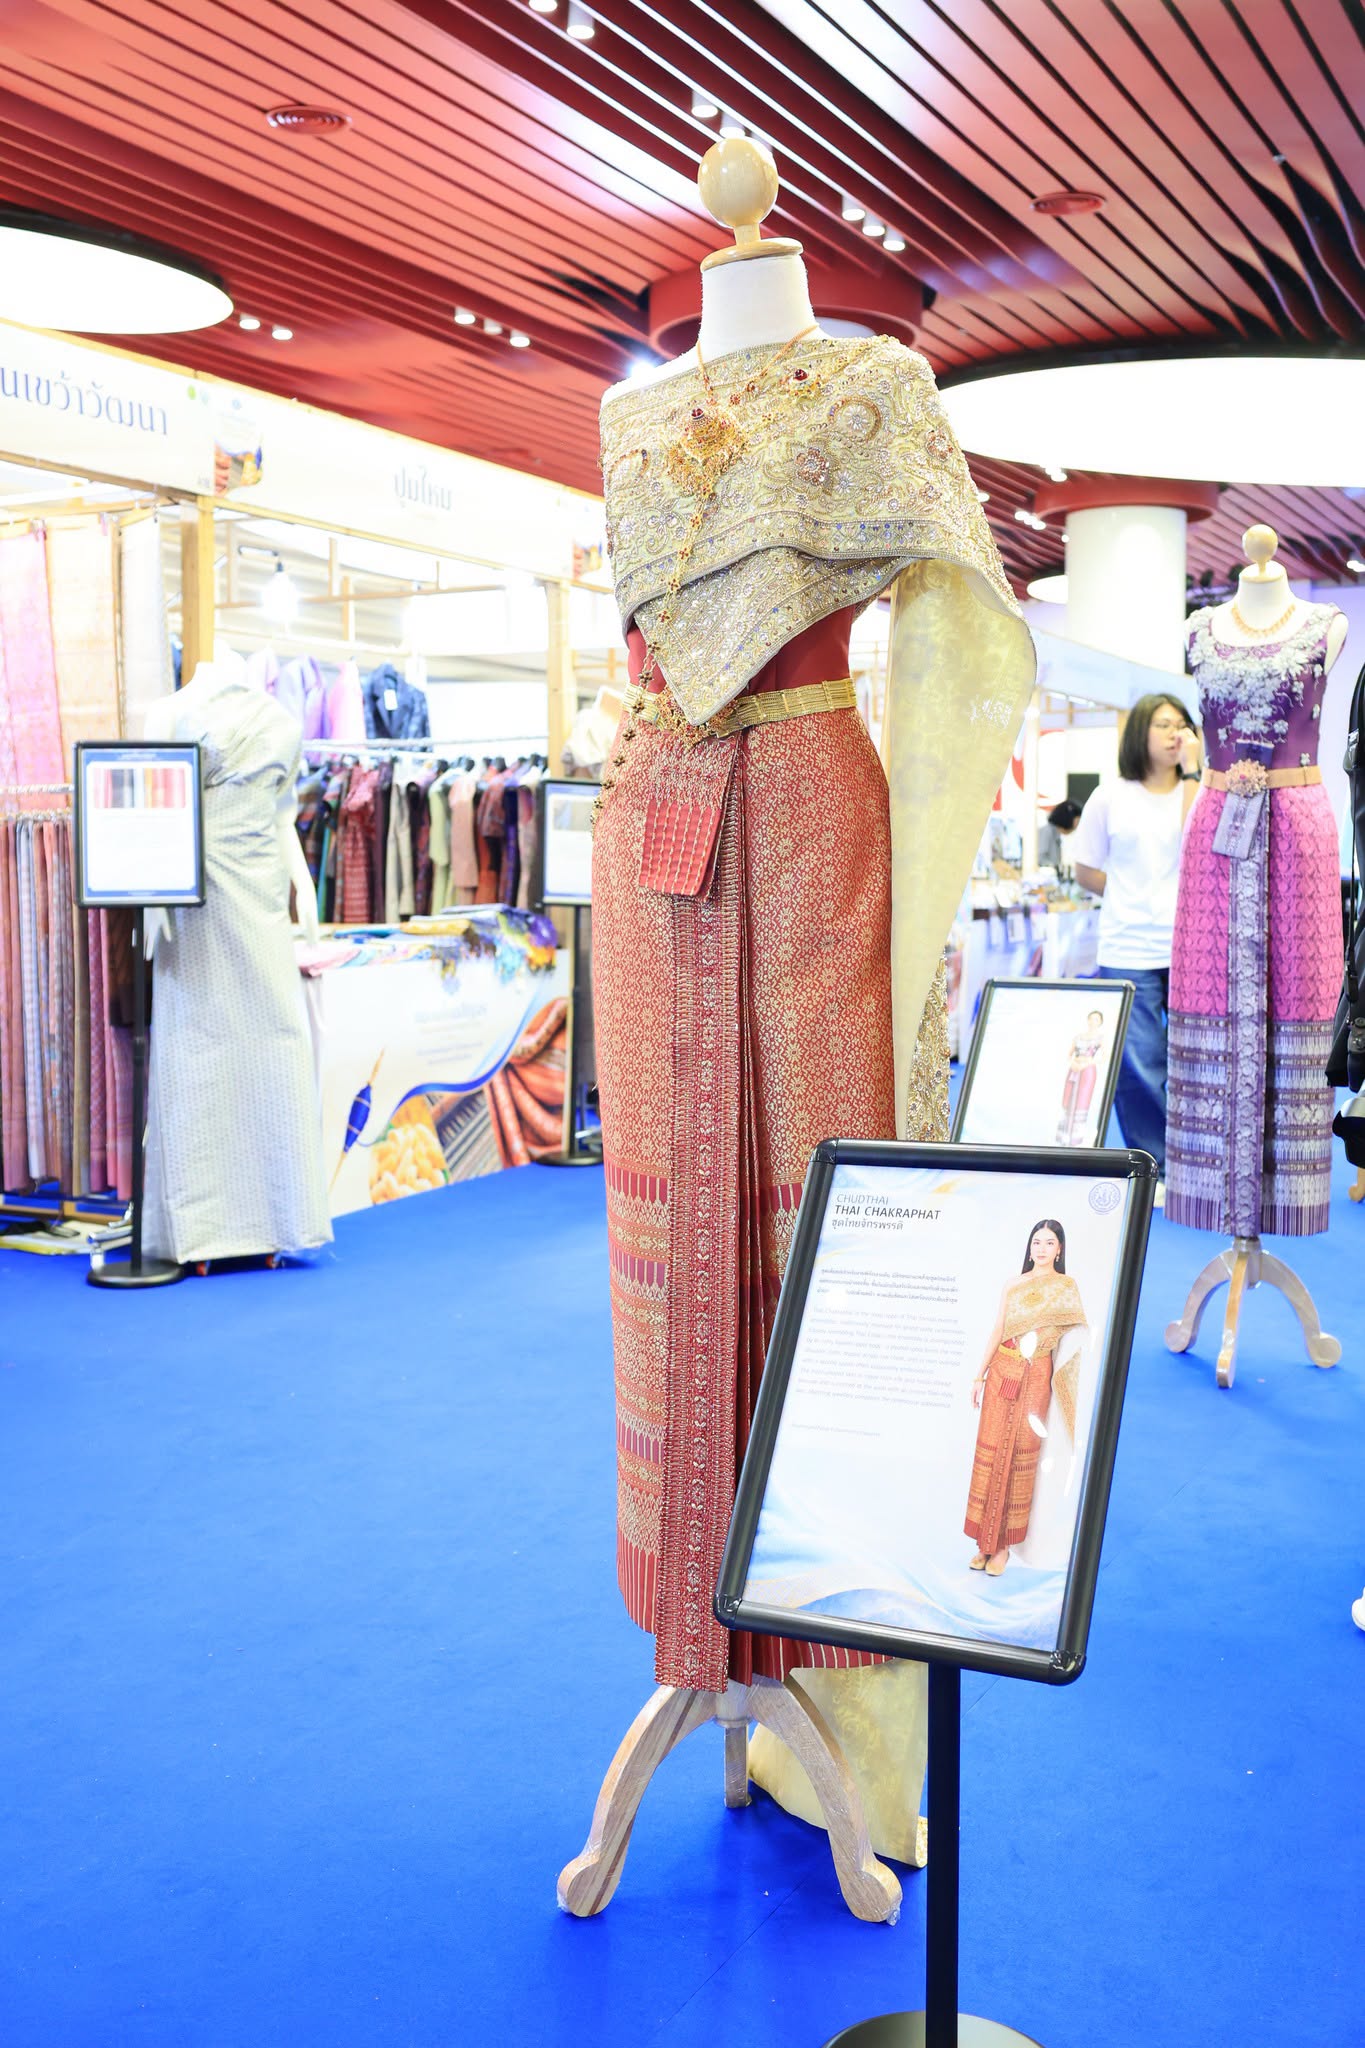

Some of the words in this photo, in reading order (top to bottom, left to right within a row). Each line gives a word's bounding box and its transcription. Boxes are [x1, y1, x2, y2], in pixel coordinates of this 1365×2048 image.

[836, 1193, 889, 1206] CHUDTHAI
[834, 1205, 861, 1216] THAI
[864, 1206, 941, 1220] CHAKRAPHAT
[831, 1218, 904, 1231] ชุดไทยจักรพรรดิ
